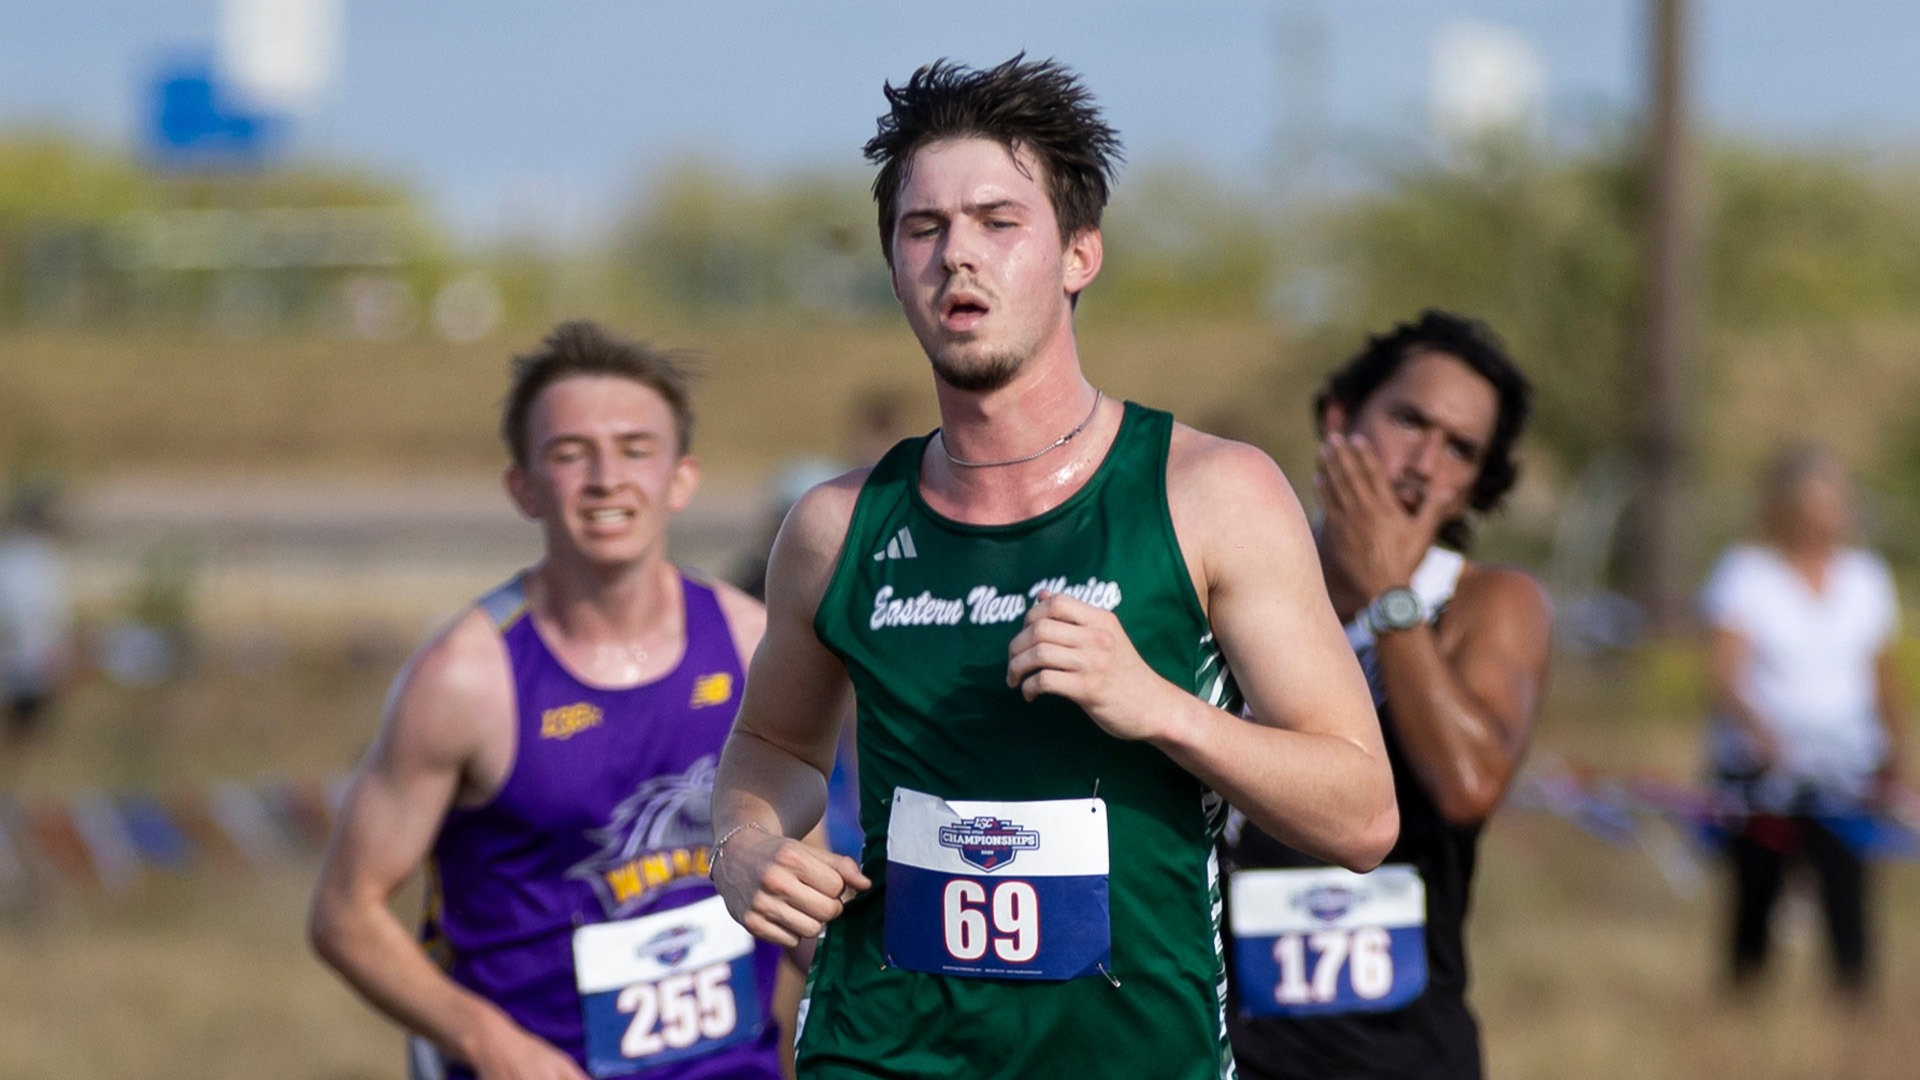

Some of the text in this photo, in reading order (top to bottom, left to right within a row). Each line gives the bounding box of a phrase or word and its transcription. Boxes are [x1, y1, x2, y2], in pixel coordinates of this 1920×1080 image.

[870, 585, 964, 630] Eastern
[967, 585, 1026, 625] New
[942, 832, 1035, 847] CHAMPIONSHIPS
[943, 878, 1041, 963] 69
[1272, 927, 1393, 1004] 176
[617, 962, 737, 1058] 255
